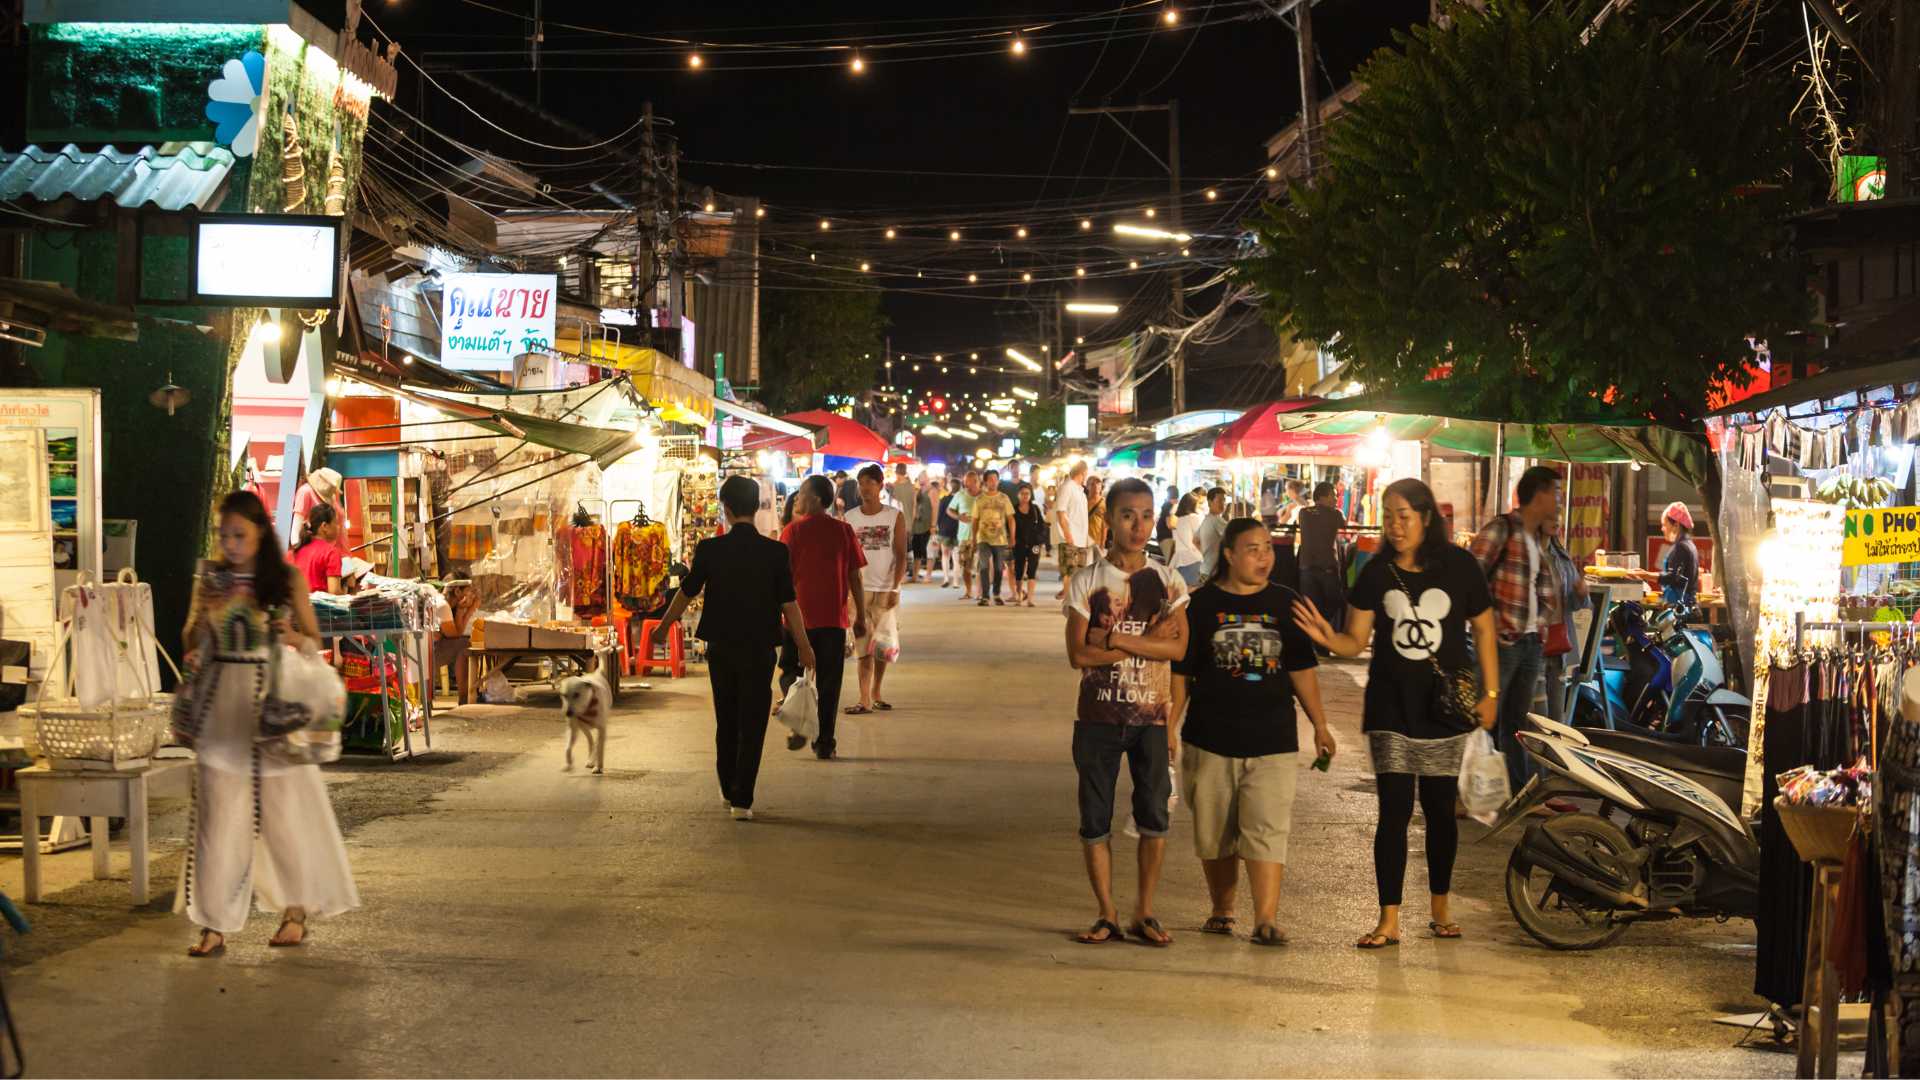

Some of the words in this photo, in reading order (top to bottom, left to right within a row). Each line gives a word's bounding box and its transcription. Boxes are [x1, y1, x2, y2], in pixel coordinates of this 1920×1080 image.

[1844, 512, 1874, 538] NO
[1110, 671, 1148, 686] FALL
[1097, 687, 1112, 701] IN
[1116, 688, 1157, 704] LOVE
